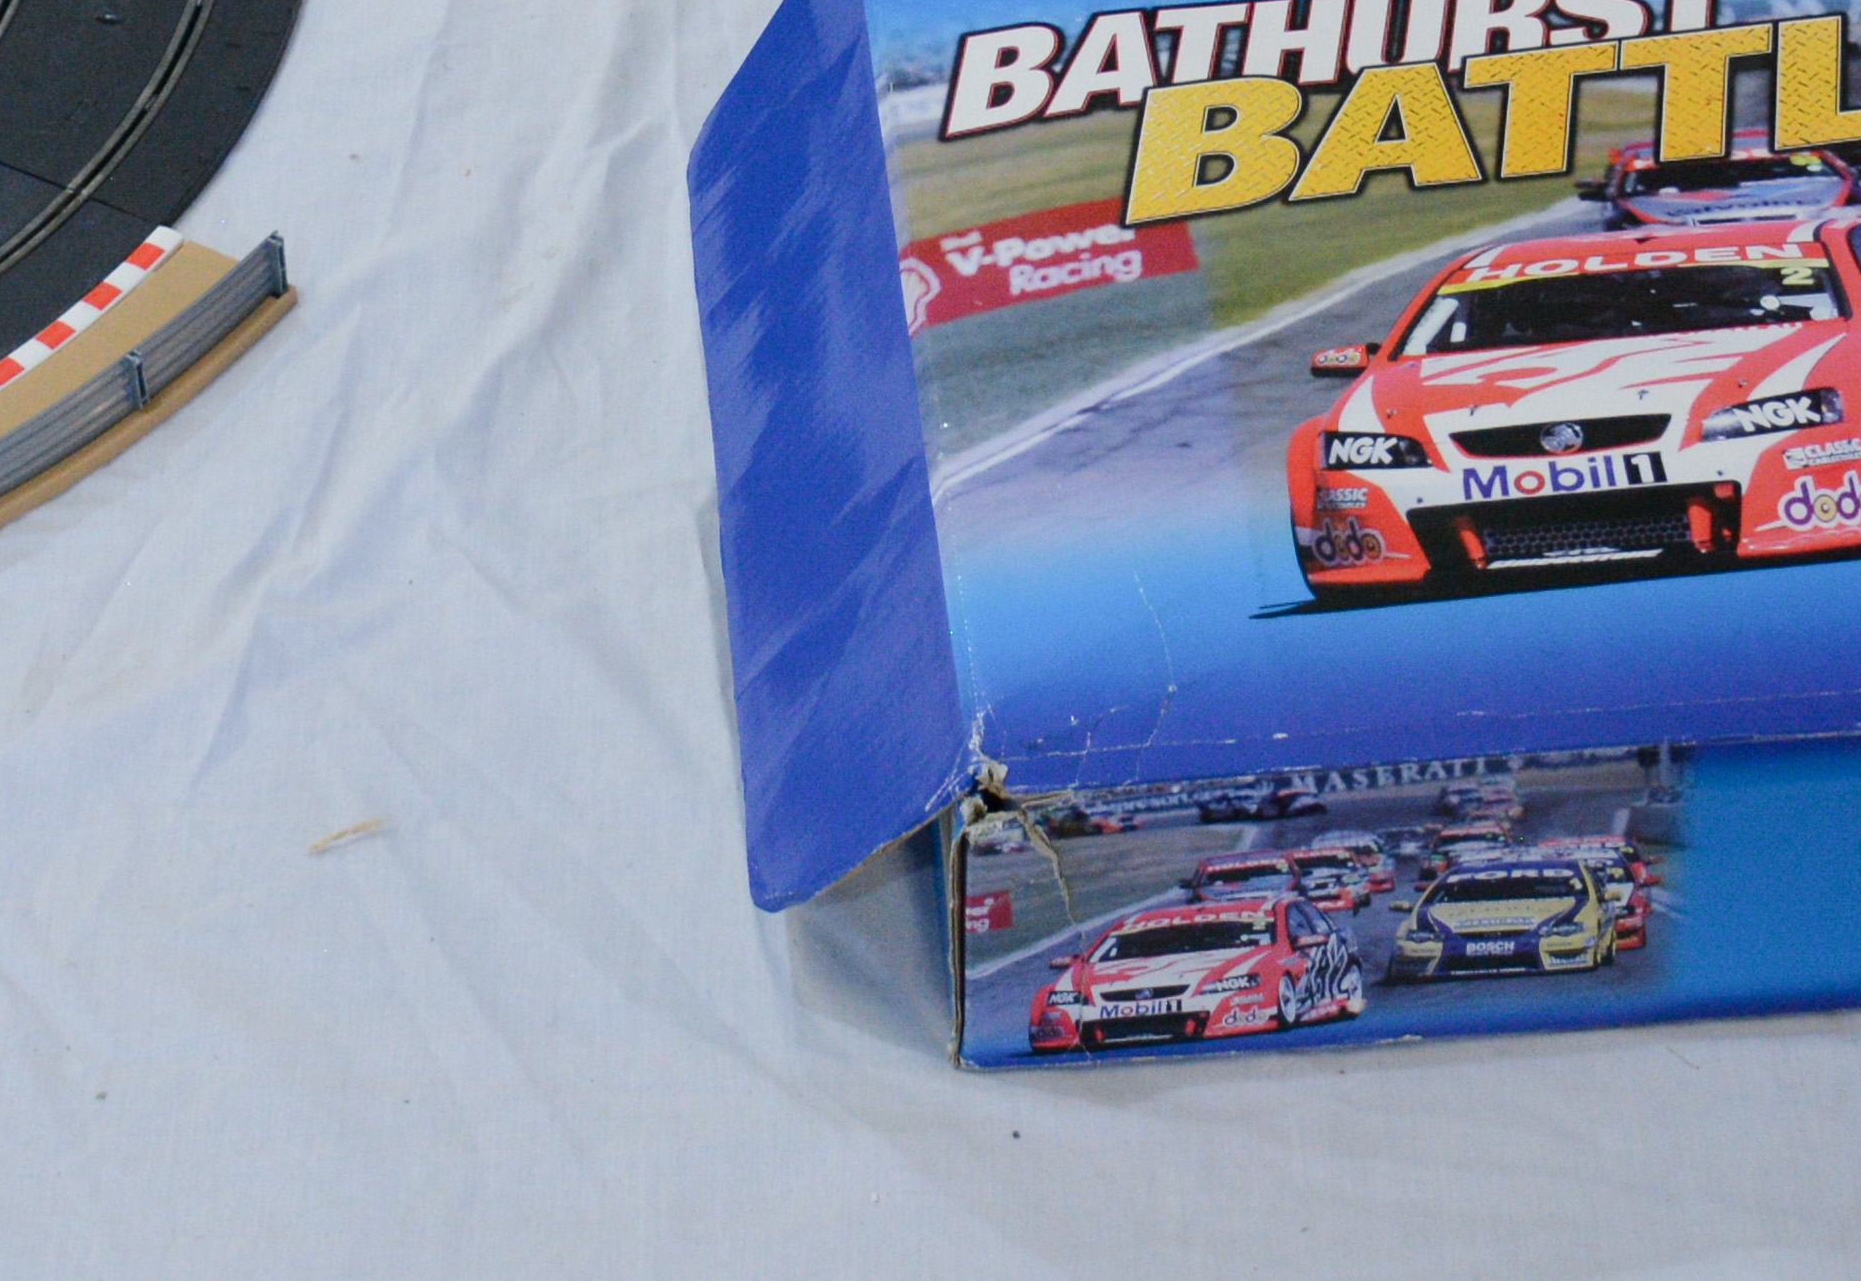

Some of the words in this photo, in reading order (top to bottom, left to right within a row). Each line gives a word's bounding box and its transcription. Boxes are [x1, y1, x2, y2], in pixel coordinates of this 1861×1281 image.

[1471, 244, 1802, 282] HOLDEN
[1780, 267, 1814, 286] 2
[1734, 393, 1821, 435] NGK
[1328, 437, 1398, 465] NGK
[1462, 455, 1617, 501] Mobil
[1446, 868, 1575, 883] FORD
[1123, 910, 1265, 932] HOLDEN
[1466, 940, 1515, 953] BOSCH
[1100, 999, 1163, 1019] Mobil
